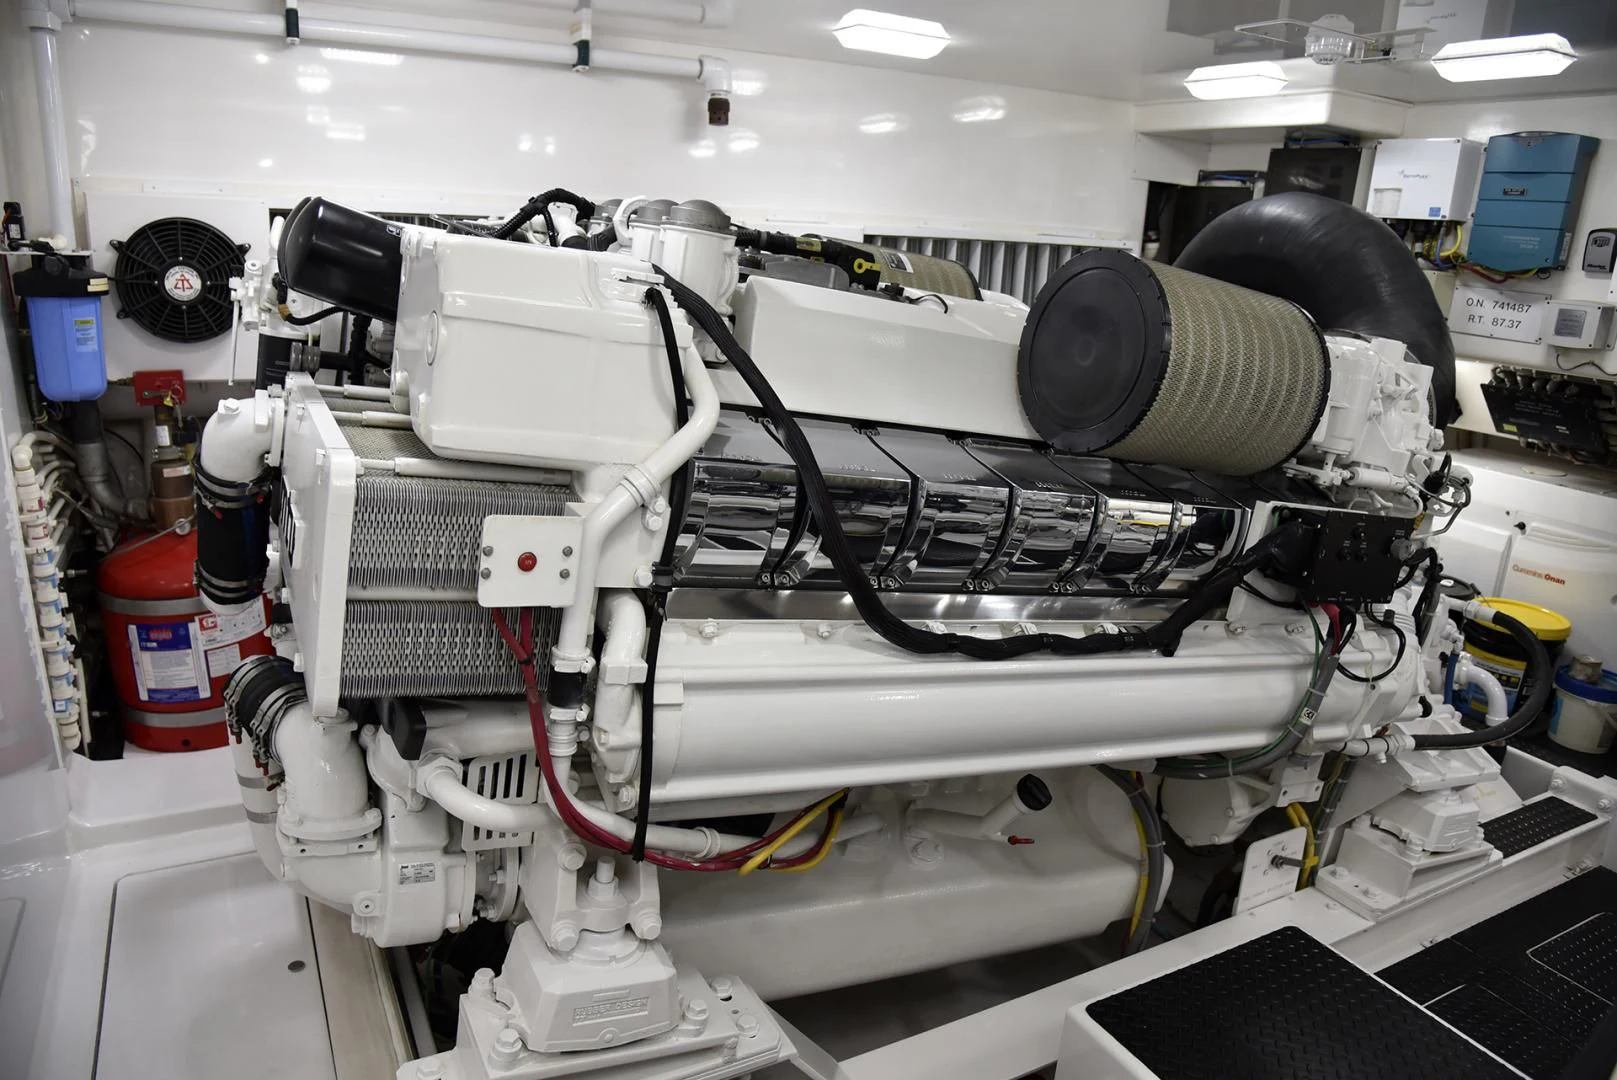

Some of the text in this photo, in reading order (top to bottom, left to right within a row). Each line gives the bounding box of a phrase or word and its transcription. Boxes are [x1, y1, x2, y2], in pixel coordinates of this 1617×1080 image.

[1466, 297, 1532, 313] O.N. 741487
[1468, 314, 1522, 329] R.T. 87.37
[1544, 574, 1565, 584] Onan
